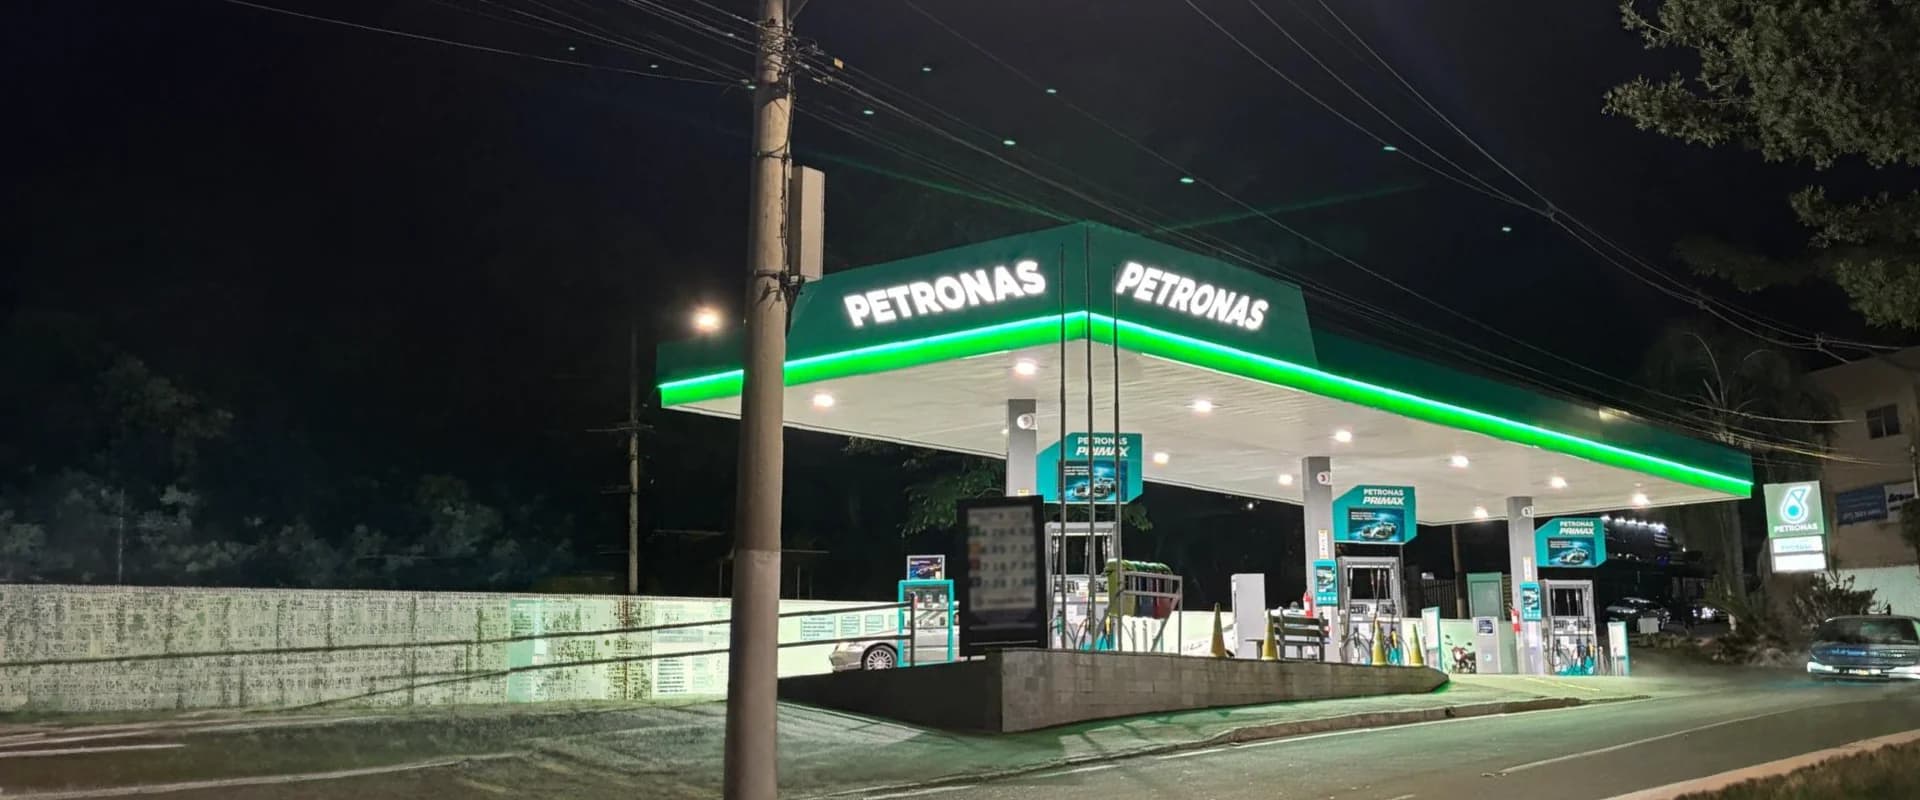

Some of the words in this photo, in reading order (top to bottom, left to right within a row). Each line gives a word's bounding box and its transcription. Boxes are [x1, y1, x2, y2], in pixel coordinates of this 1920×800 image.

[844, 260, 1046, 327] PETRONAS
[1115, 262, 1269, 330] PETRONAS
[1363, 488, 1404, 496] PETRONAS
[1362, 496, 1404, 505] PRIMAX
[1773, 522, 1818, 533] PETRONAS
